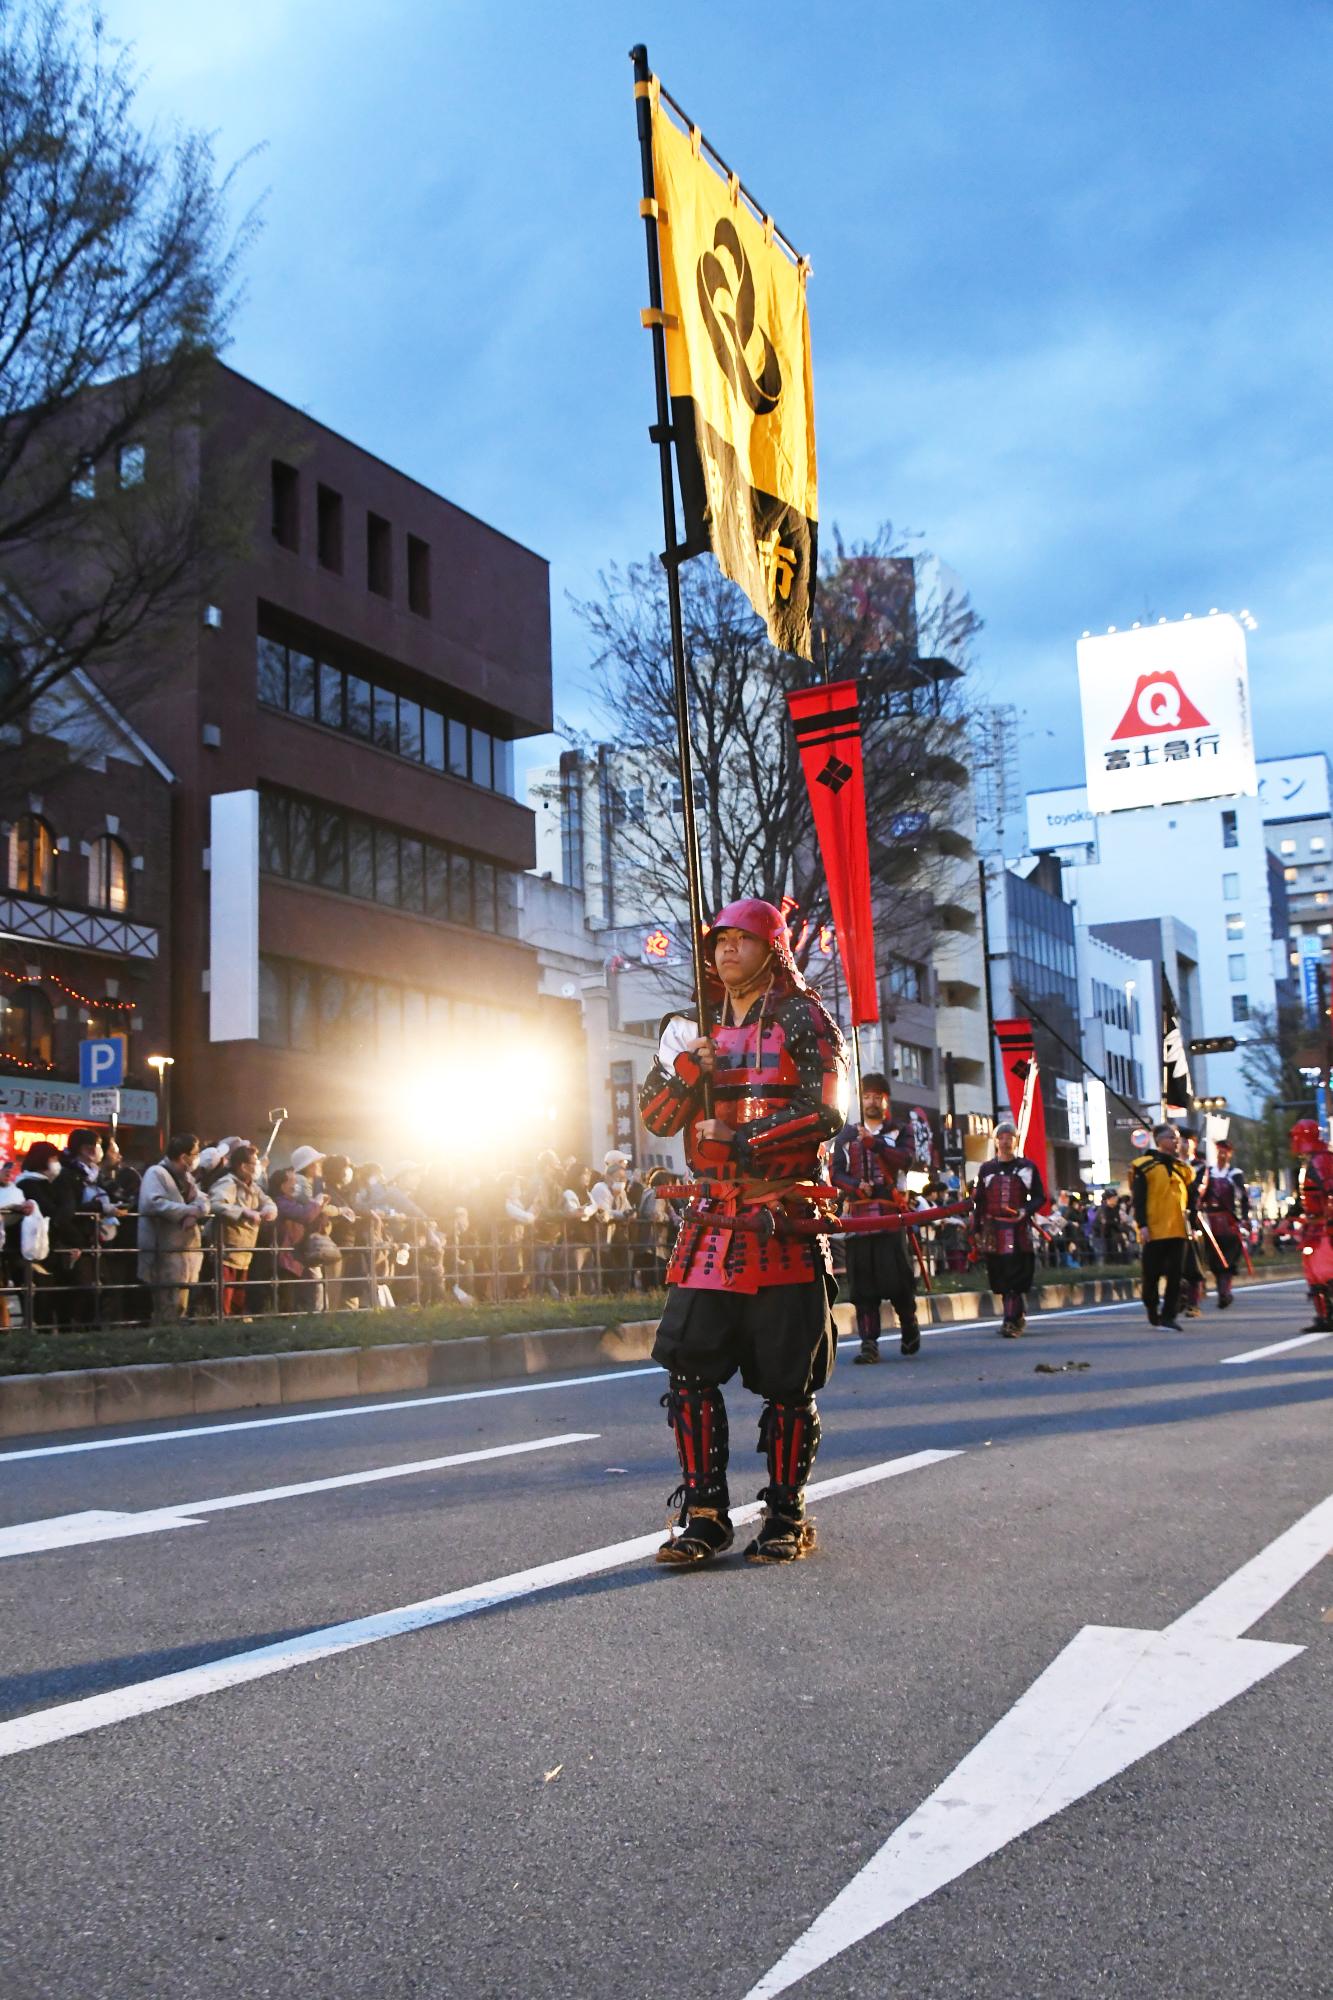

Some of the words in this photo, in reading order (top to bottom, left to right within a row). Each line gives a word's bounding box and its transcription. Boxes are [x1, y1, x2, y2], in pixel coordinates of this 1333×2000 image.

[1136, 681, 1182, 728] Q
[1104, 733, 1220, 771] 富士急行
[1046, 810, 1094, 826] toyoko
[91, 1043, 115, 1083] P
